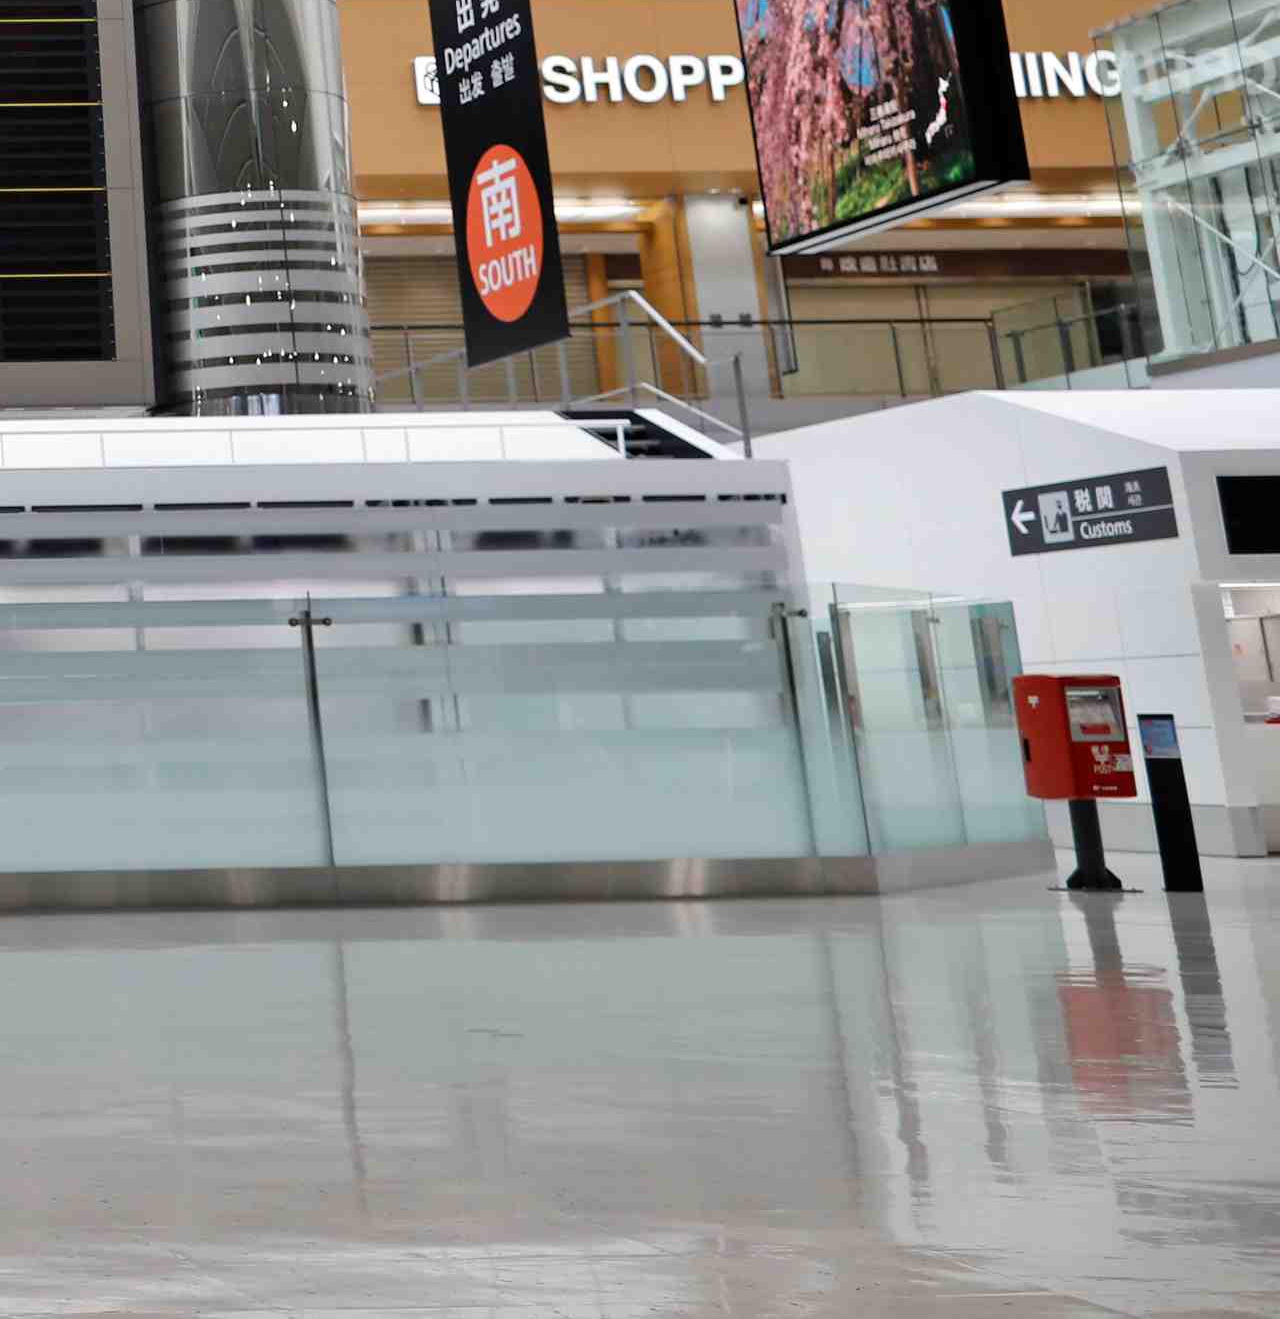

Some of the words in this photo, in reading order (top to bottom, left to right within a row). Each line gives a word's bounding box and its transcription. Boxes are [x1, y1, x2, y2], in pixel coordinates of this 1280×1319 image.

[444, 13, 522, 75] Departures
[541, 54, 746, 104] SHOPP
[476, 157, 521, 248] 南
[478, 243, 537, 297] SOUTH
[1080, 519, 1134, 540] Customs
